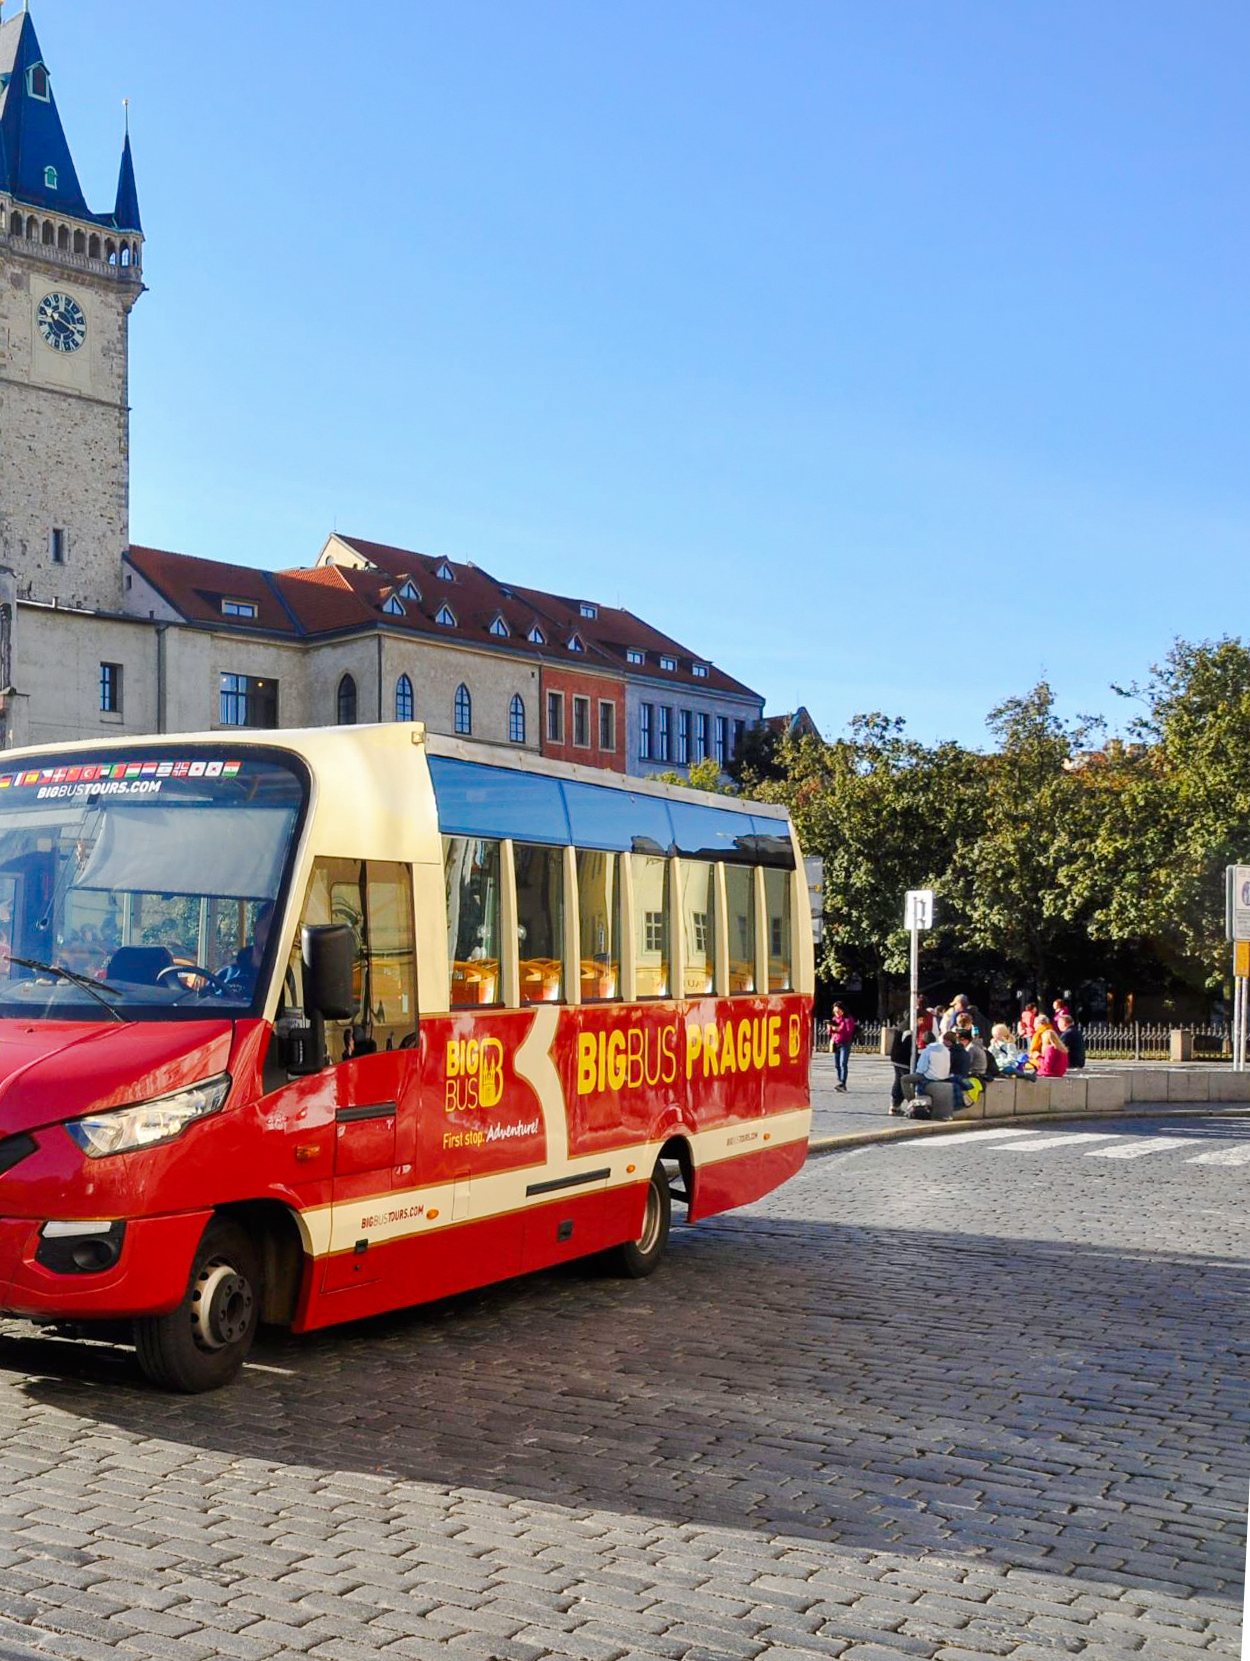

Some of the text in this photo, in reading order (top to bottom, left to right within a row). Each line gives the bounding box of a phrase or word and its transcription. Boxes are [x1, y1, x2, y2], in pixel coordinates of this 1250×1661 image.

[37, 780, 161, 799] BIGBUSTOURS.COM
[446, 1038, 480, 1077] BIG
[685, 1015, 782, 1080] PRAGUE
[445, 1077, 479, 1112] BUS
[443, 1130, 463, 1150] First
[361, 1204, 424, 1229] BIGBUSTOURS.COM
